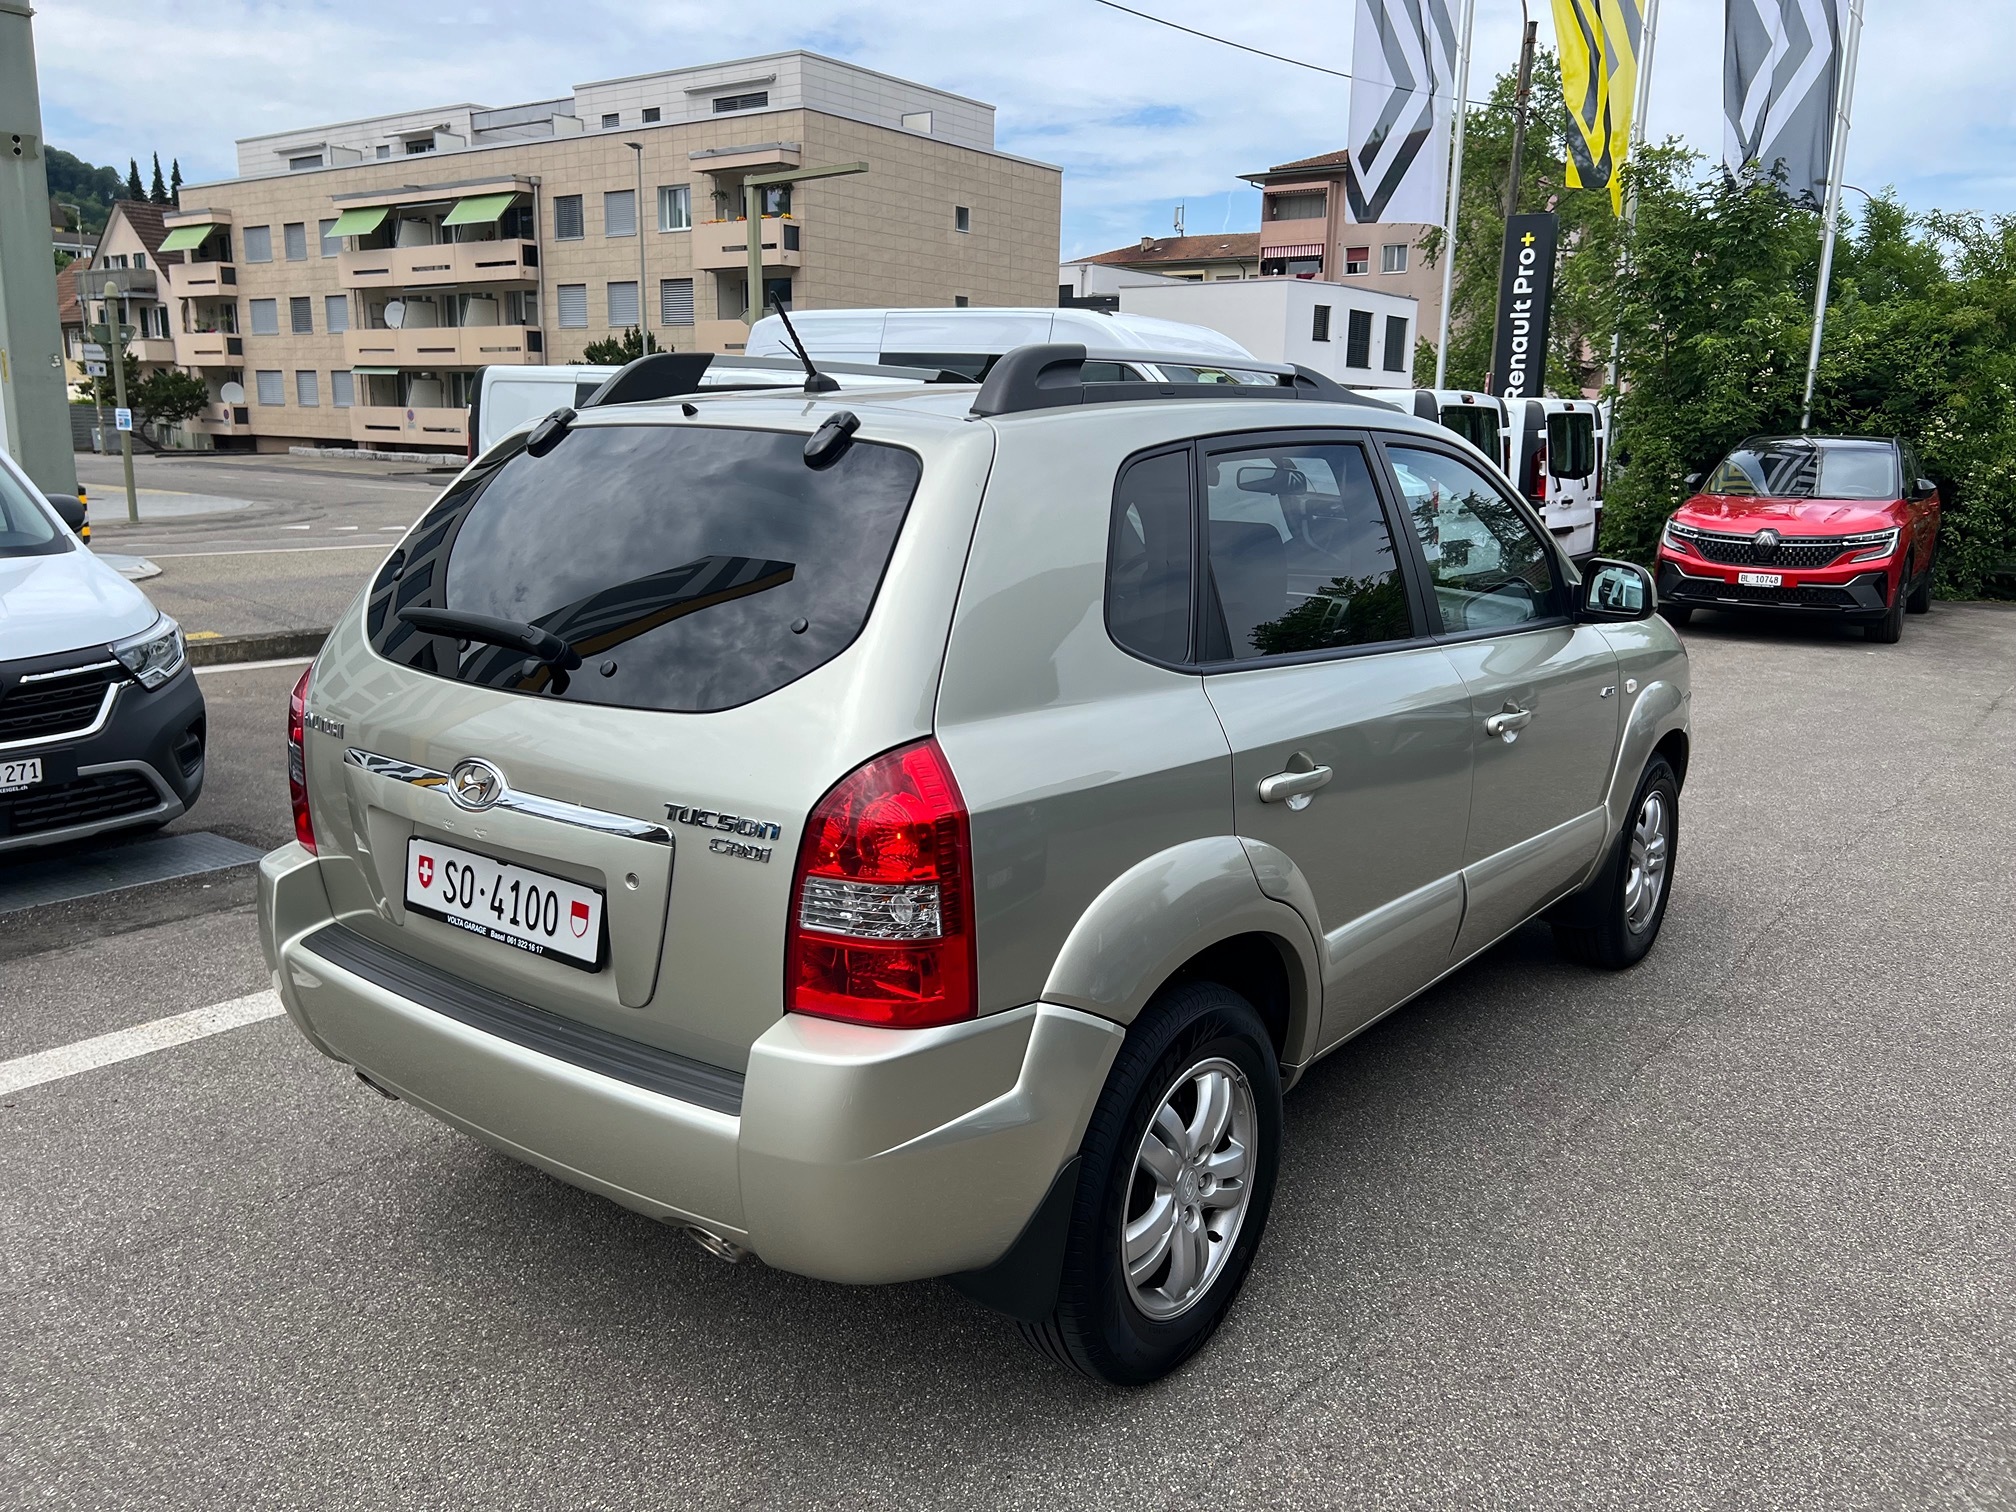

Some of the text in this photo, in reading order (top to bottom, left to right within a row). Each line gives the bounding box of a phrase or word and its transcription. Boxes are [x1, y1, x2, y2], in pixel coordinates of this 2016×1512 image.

[1503, 231, 1536, 399] Renault Pro+
[1756, 575, 1778, 584] 10748
[5, 762, 38, 783] 271
[663, 801, 782, 841] TUCSON
[447, 915, 463, 927] VOLTA
[464, 921, 486, 935] GARAGE
[490, 930, 505, 941] Basel
[517, 939, 527, 949] 322
[536, 945, 543, 953] 17
